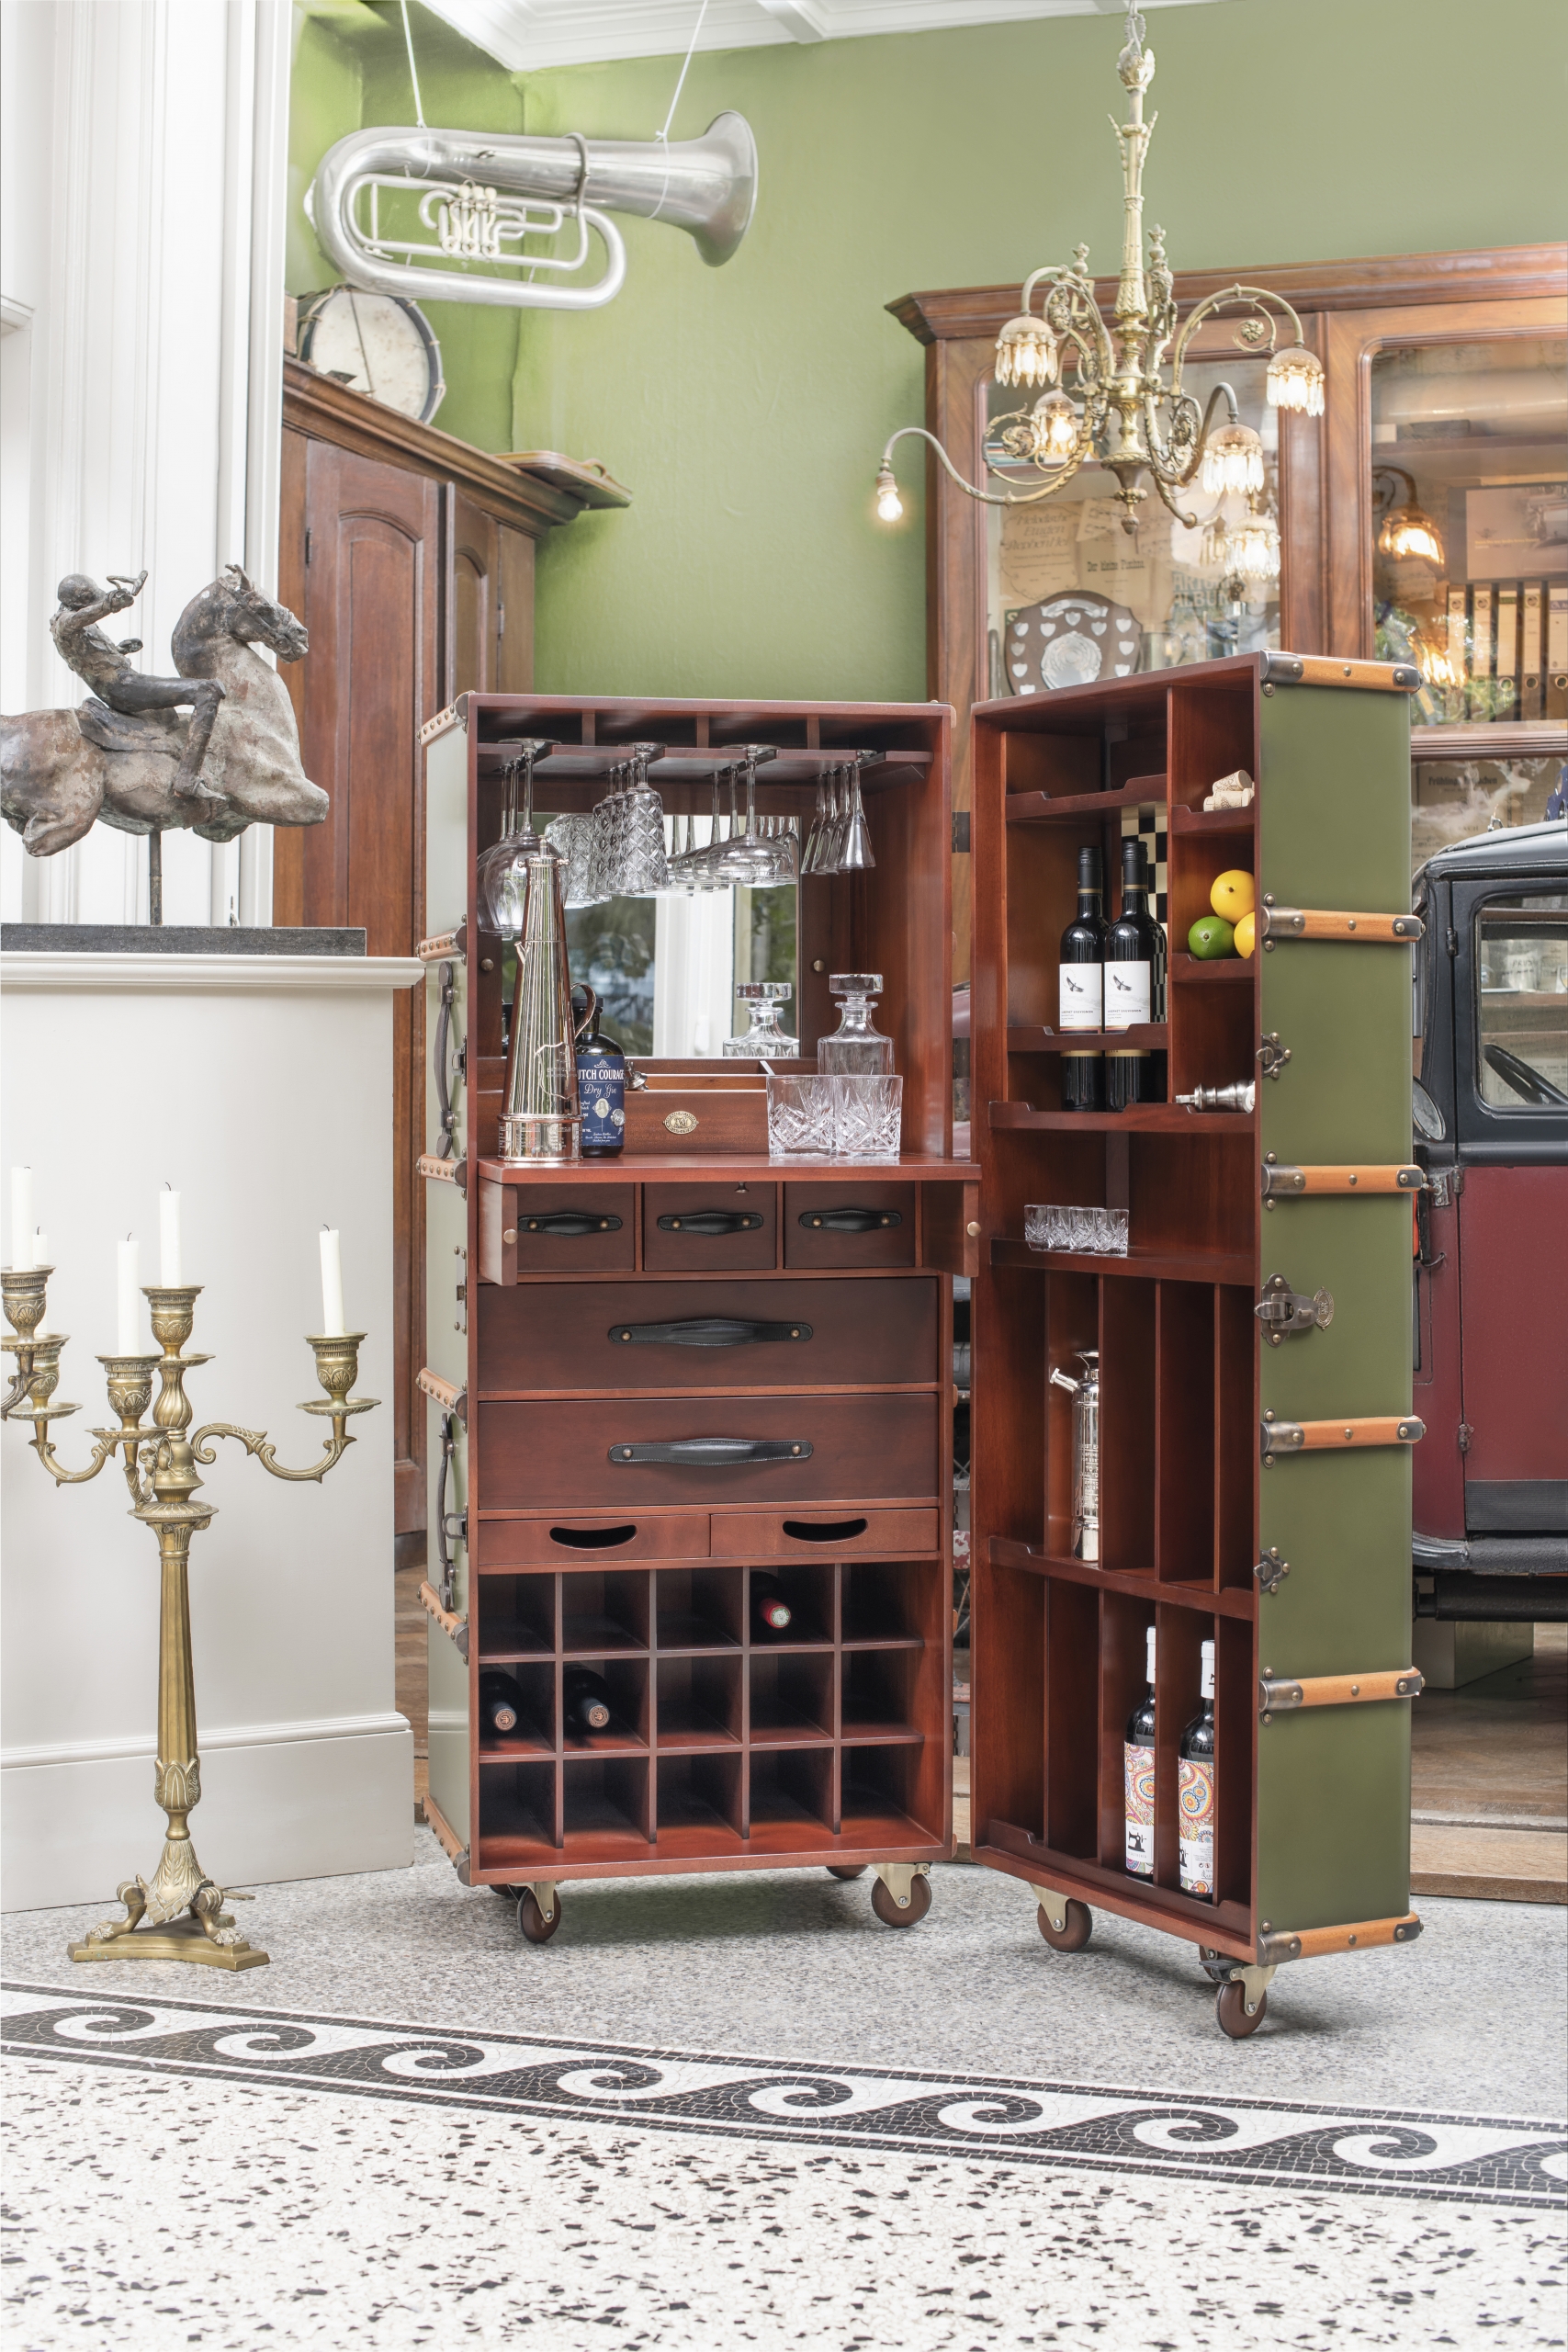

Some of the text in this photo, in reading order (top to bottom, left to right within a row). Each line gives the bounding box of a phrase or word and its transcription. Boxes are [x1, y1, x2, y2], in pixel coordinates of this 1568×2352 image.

[598, 1069, 625, 1080] COURAGE
[583, 1083, 617, 1098] Dry Gin
